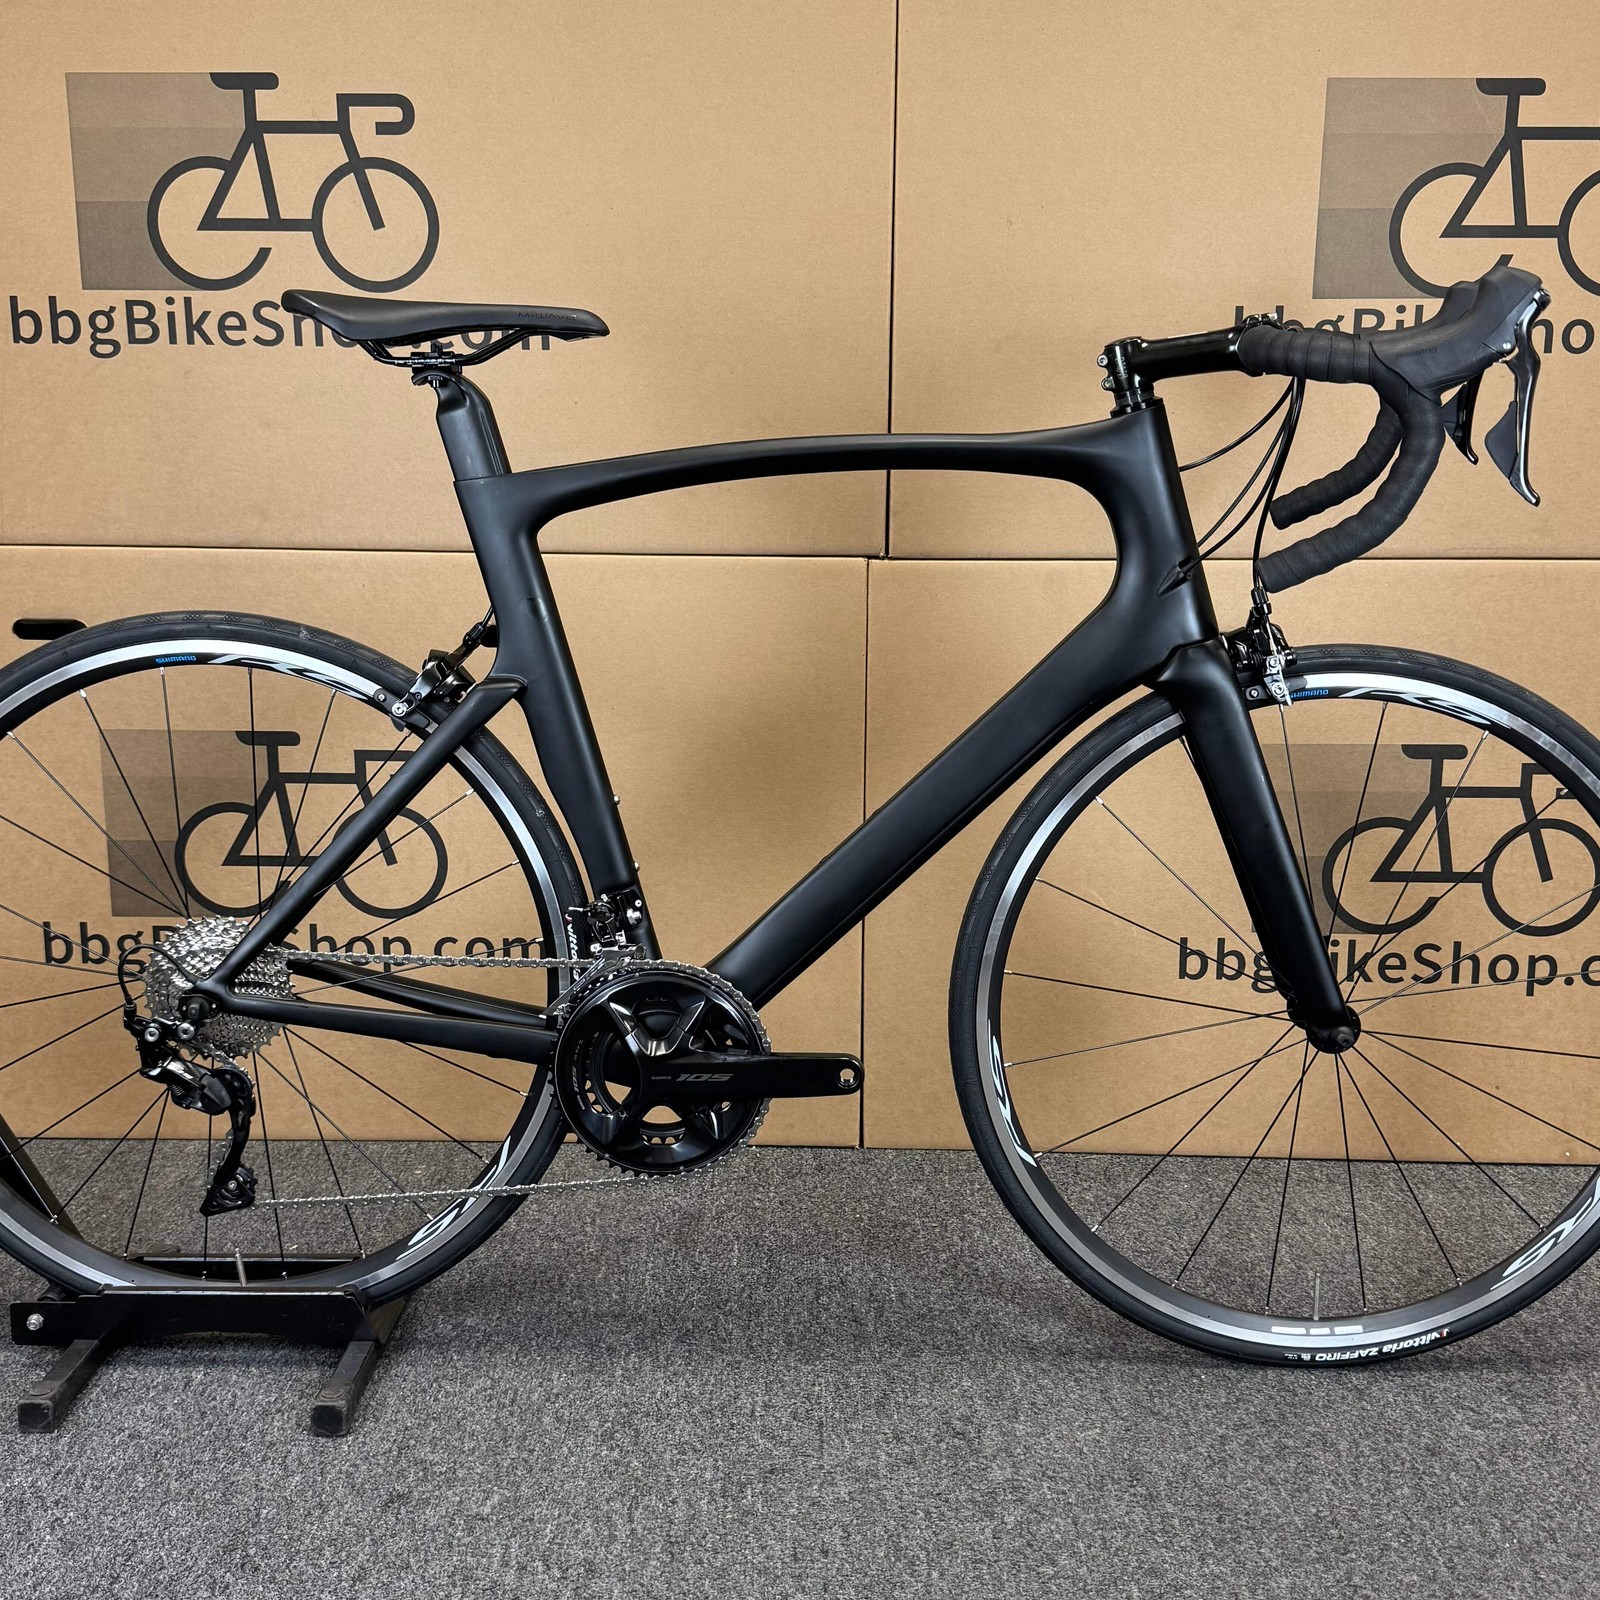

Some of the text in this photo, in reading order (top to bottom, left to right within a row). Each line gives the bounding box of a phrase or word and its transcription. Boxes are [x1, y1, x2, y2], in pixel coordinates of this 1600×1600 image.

[9, 295, 550, 359] bbgBikeSh.o
[155, 655, 197, 664] SHIMANO
[42, 921, 547, 977] bbghopcom
[566, 923, 581, 981] vittoa
[1178, 937, 1600, 997] bbgikeShop.c
[675, 1073, 735, 1082] 105
[1315, 1347, 1379, 1361] ZAFFIRO
